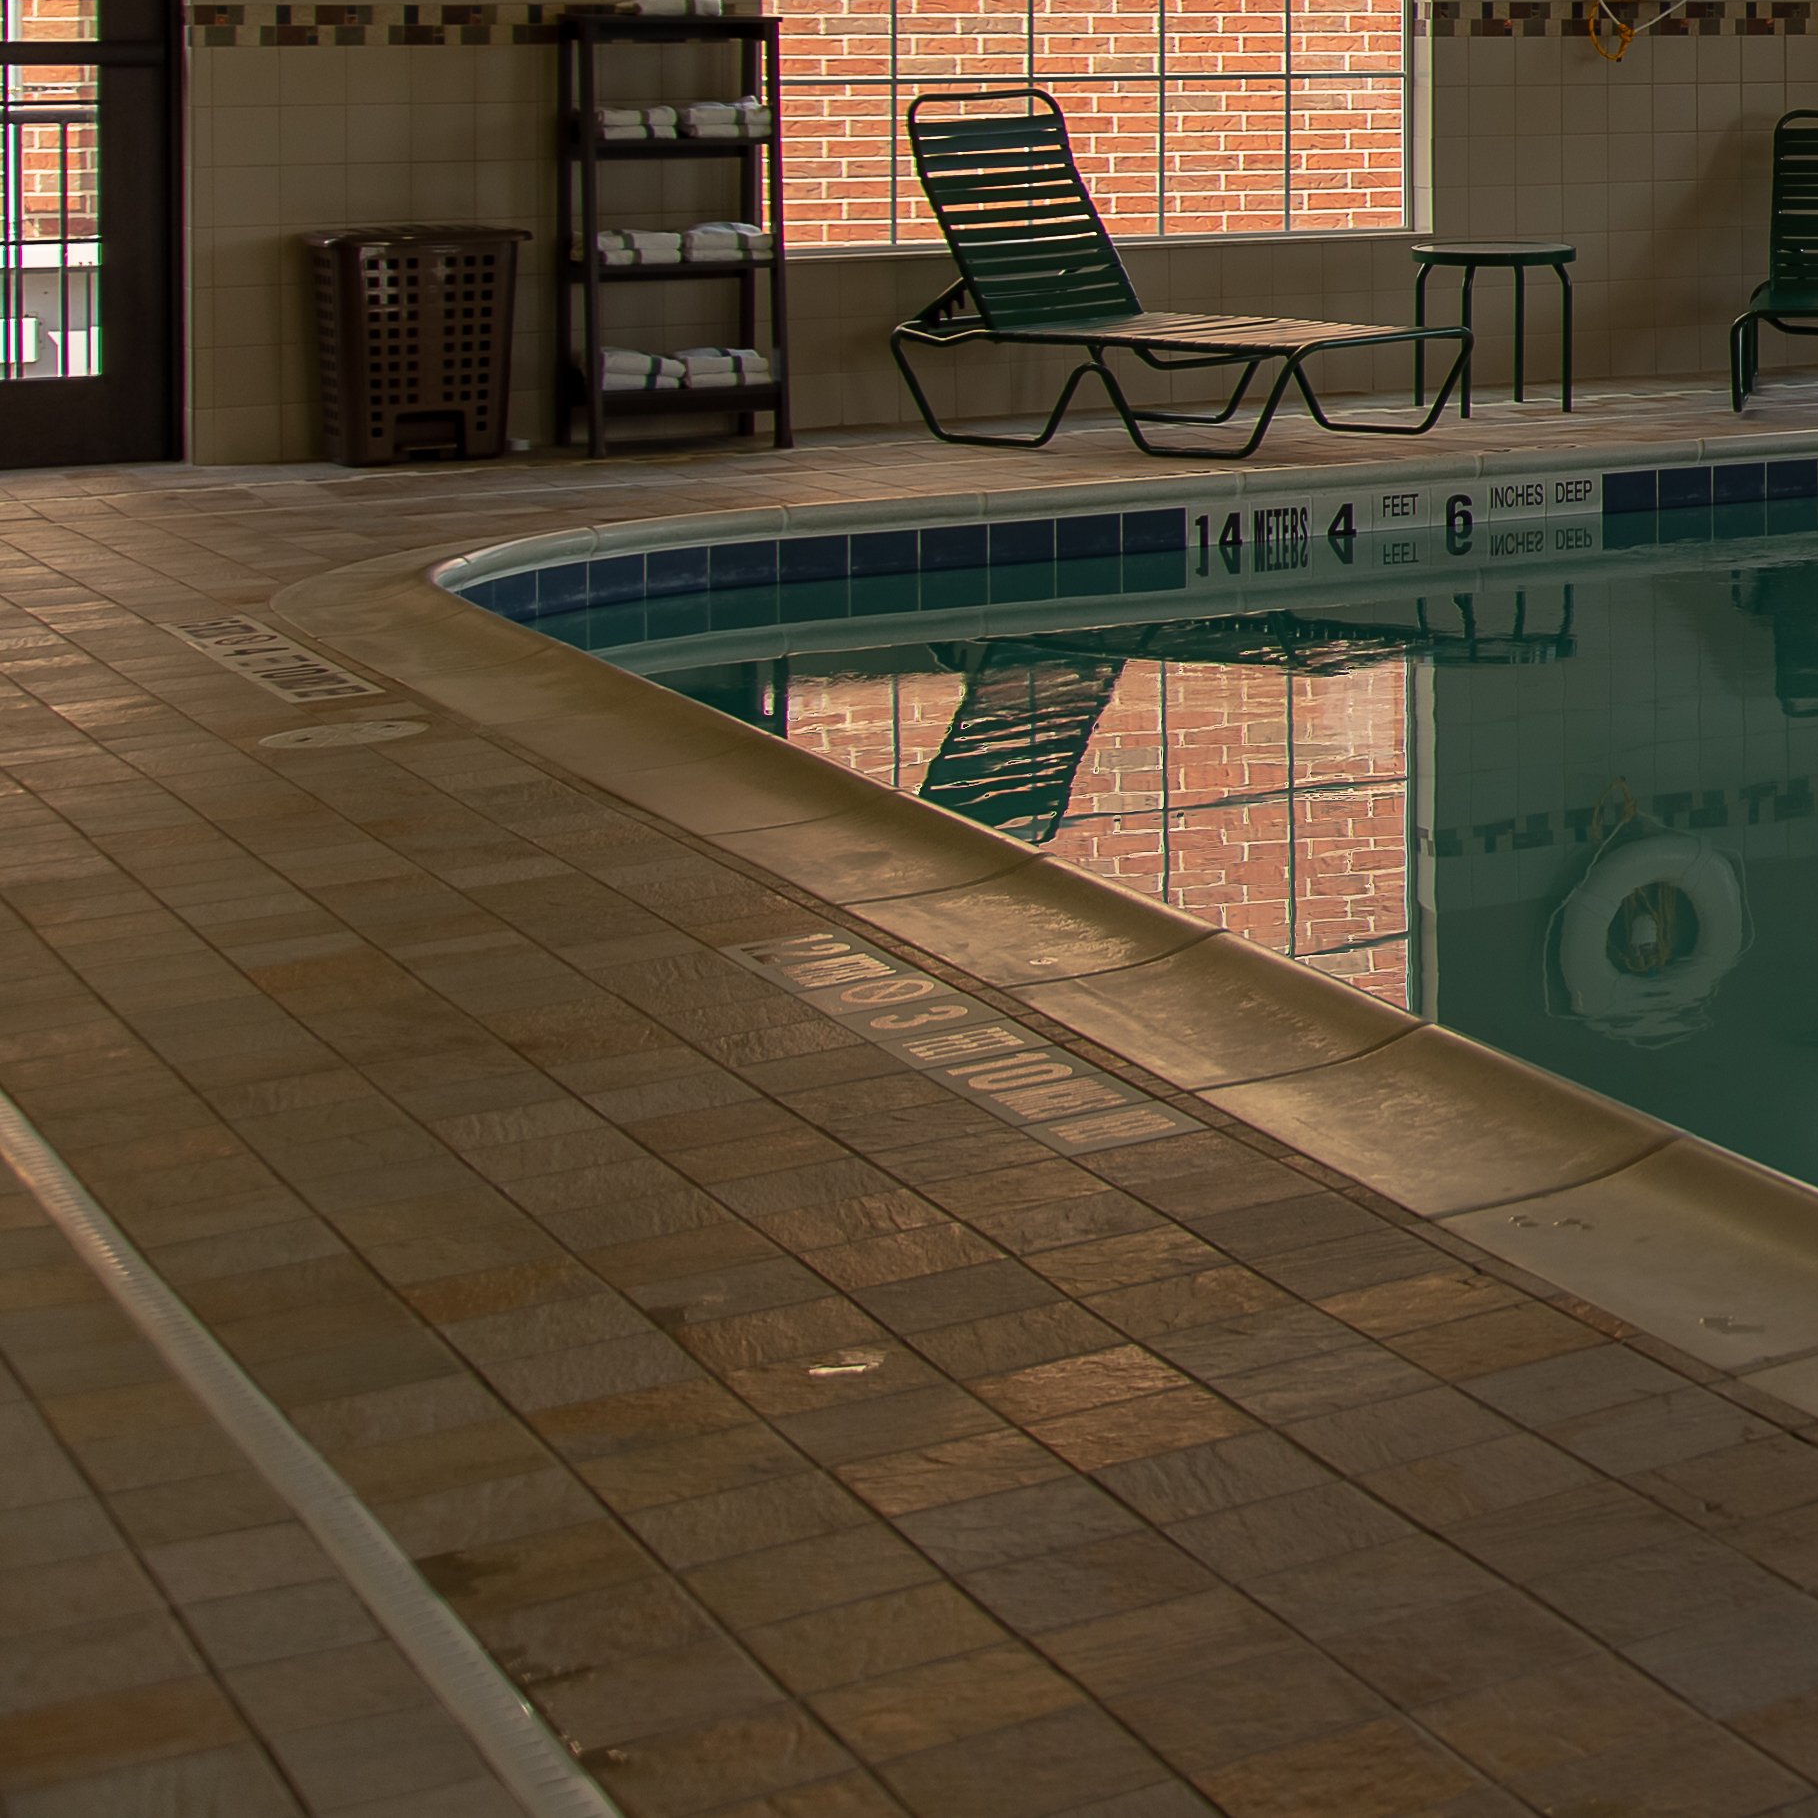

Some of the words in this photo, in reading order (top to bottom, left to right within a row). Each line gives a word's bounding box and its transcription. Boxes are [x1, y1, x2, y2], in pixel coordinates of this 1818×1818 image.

[1254, 507, 1308, 543] METERS
[1327, 502, 1357, 536] 4
[1382, 493, 1419, 518] FEET
[1445, 494, 1473, 527] 6
[1489, 483, 1544, 509] INCHES
[1555, 480, 1593, 503] DEEP
